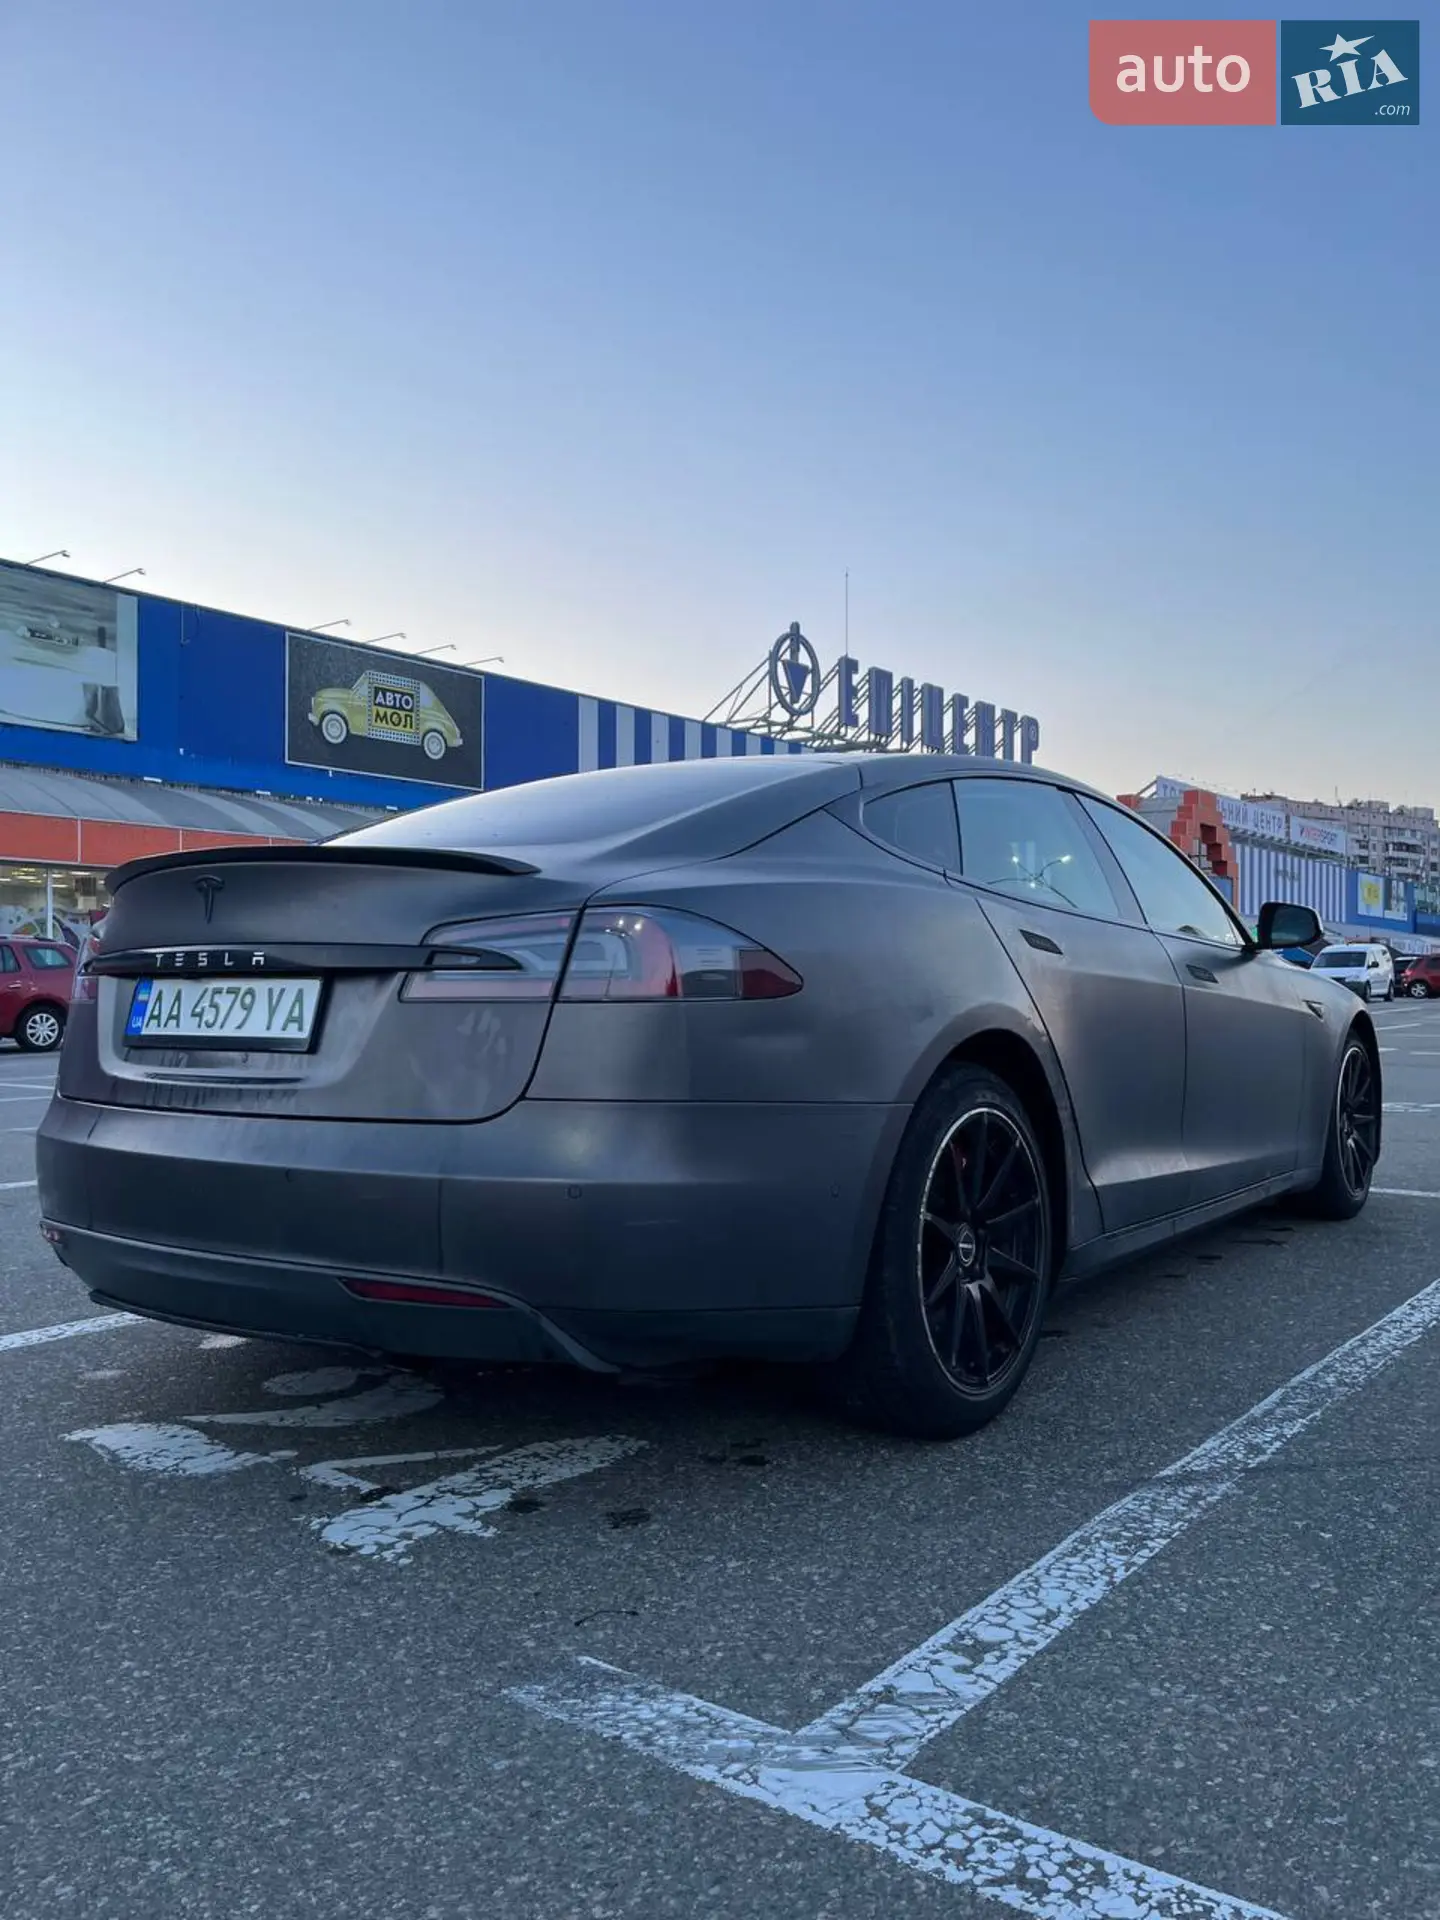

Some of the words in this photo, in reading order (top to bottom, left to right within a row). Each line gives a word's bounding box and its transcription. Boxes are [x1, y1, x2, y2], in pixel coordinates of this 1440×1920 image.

[375, 690, 413, 710] АВТО
[838, 654, 1039, 765] ЕПІЦЕНТР
[374, 708, 413, 729] МОЛ
[1253, 807, 1283, 832] ЦЕНТР
[155, 951, 265, 967] TESLA
[145, 987, 182, 1029] AA
[190, 986, 256, 1030] 4579
[265, 987, 304, 1032] YA
